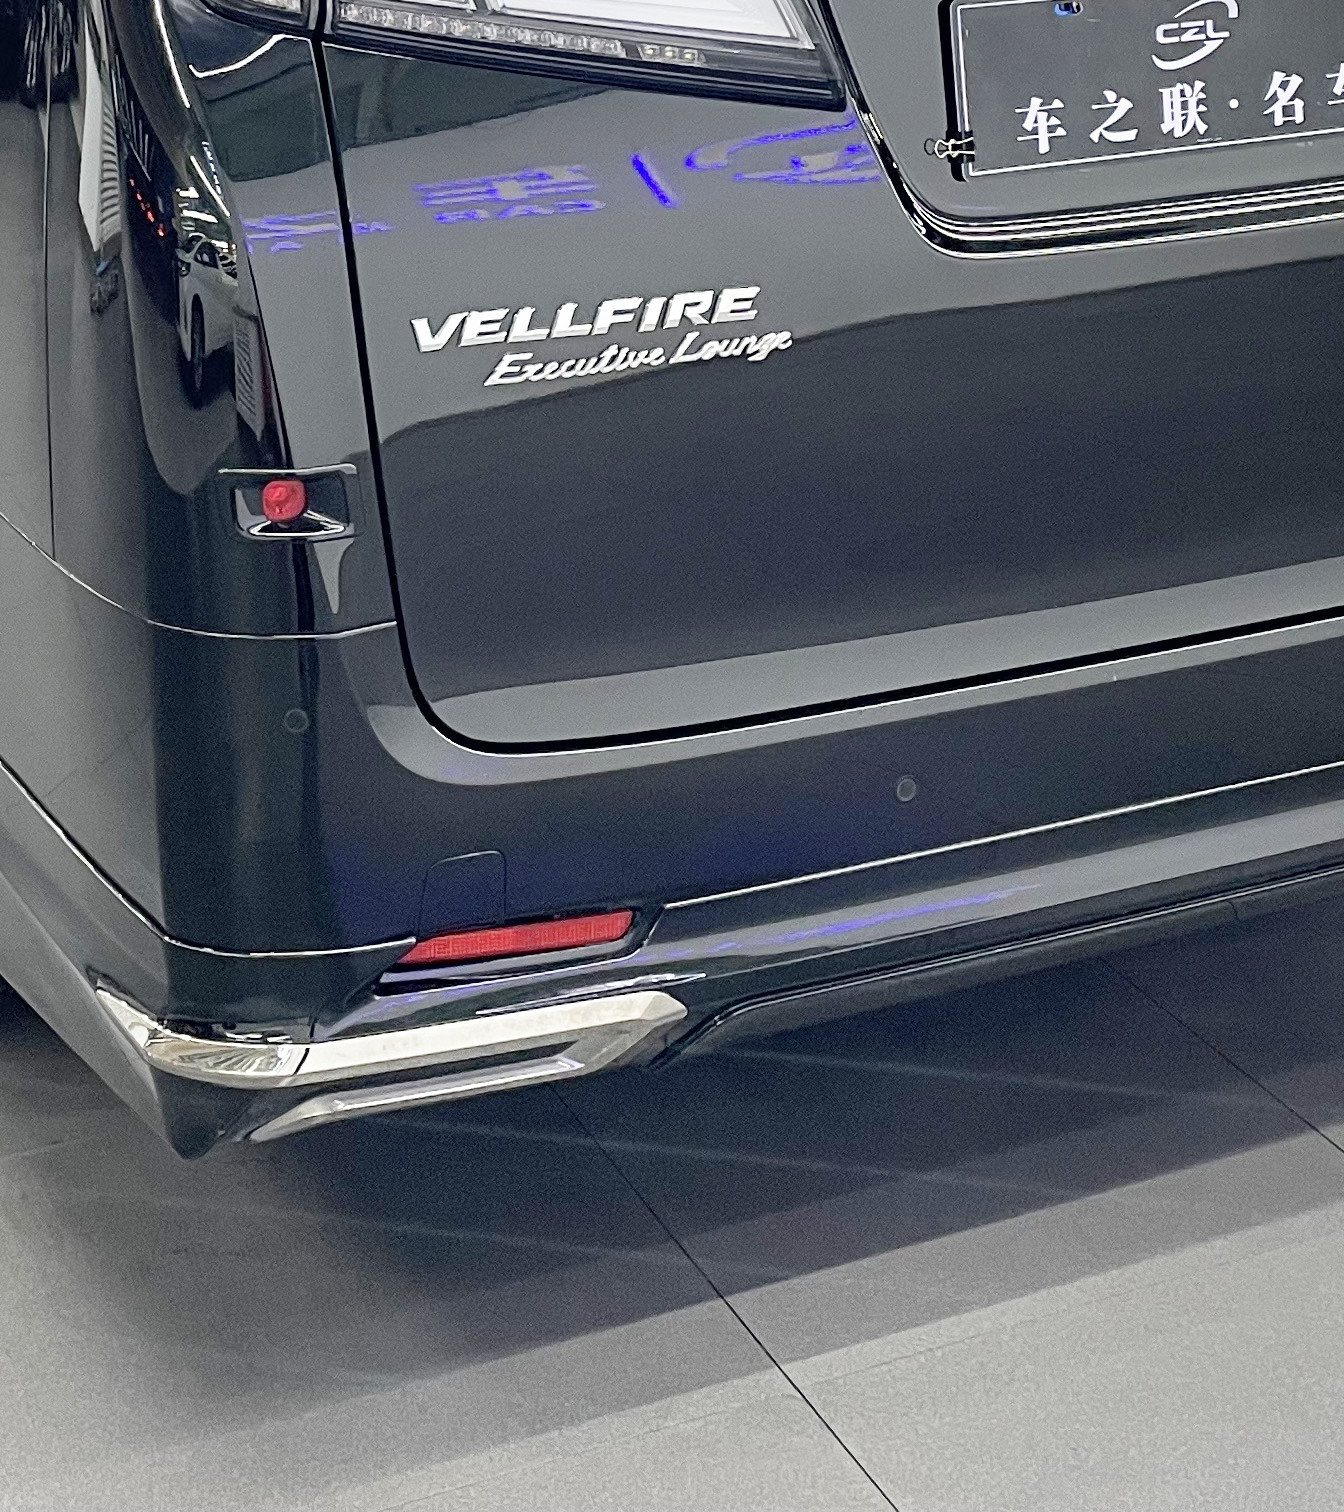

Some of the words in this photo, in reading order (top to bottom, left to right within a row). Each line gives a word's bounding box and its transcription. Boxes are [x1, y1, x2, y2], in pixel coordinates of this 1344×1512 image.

[410, 285, 762, 353] VELLFIRE
[483, 342, 666, 387] Executive
[668, 329, 794, 365] Lounge
